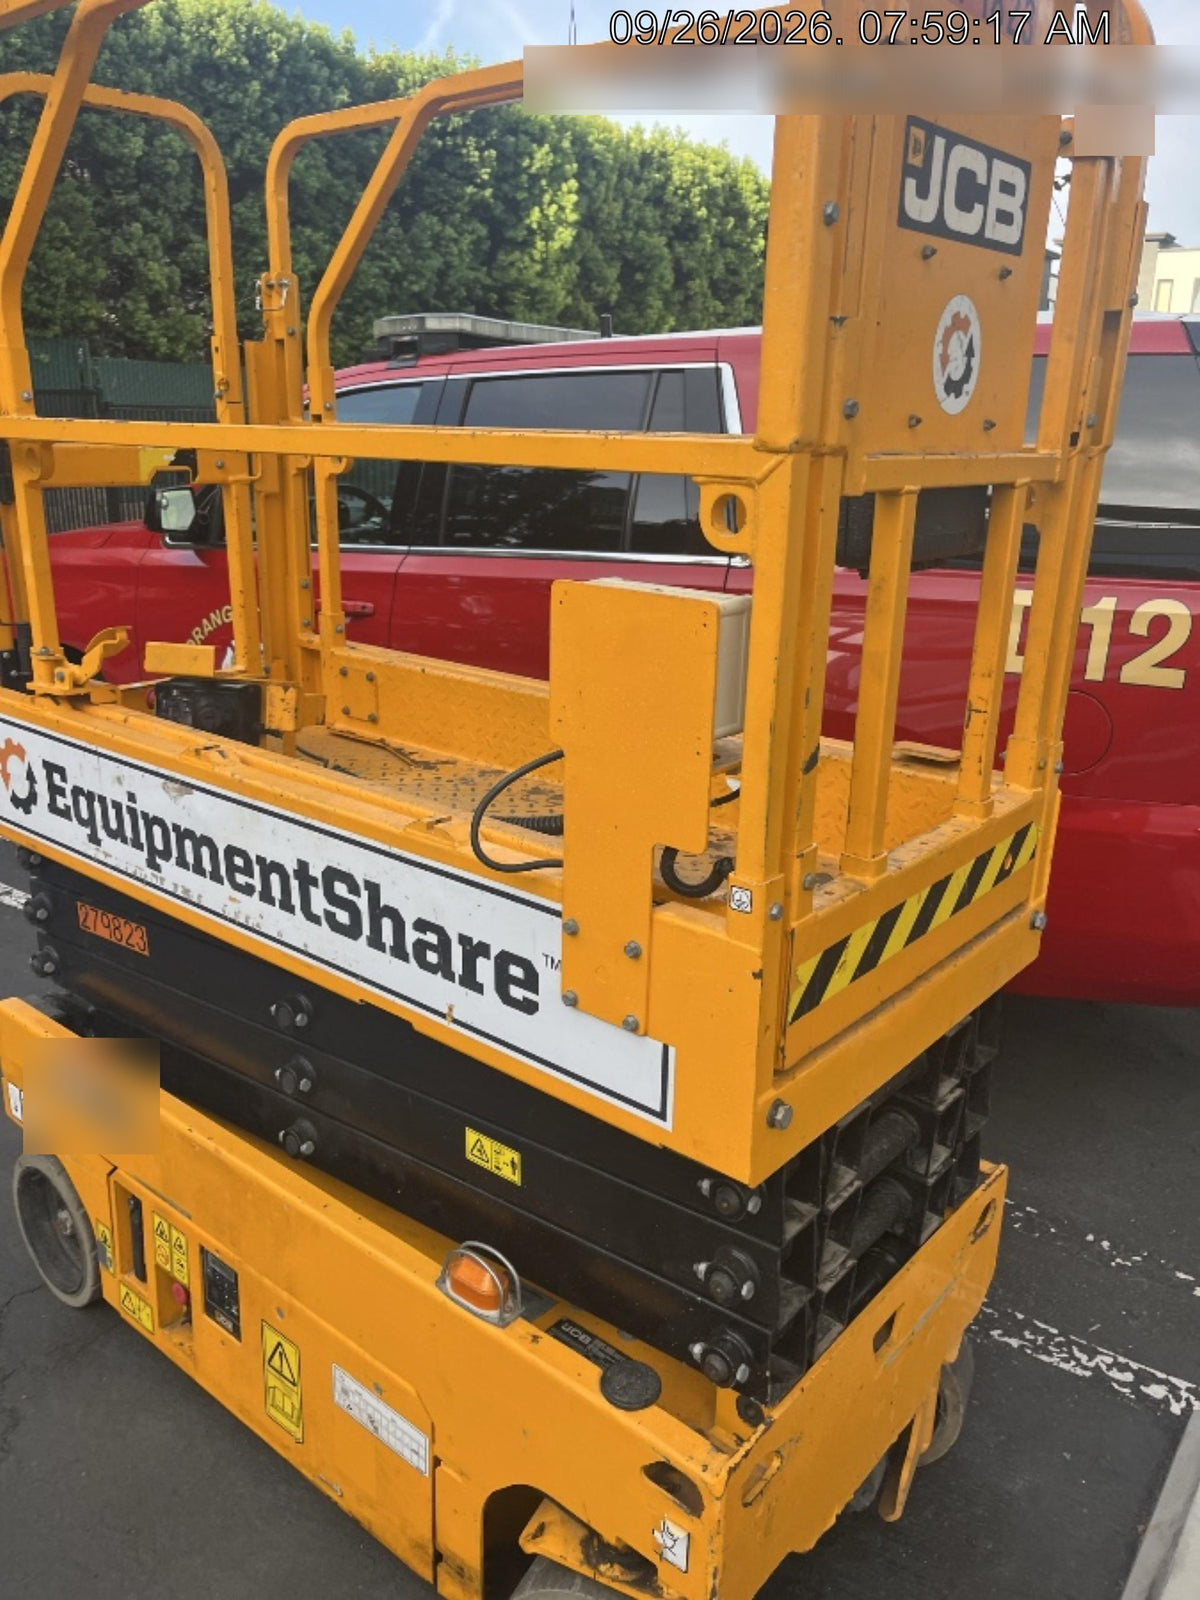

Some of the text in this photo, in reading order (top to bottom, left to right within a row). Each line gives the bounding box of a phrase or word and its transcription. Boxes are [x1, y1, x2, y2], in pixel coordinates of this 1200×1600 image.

[904, 134, 1027, 245] JCB
[42, 758, 540, 1016] EquipmentShare
[80, 904, 146, 952] 279823
